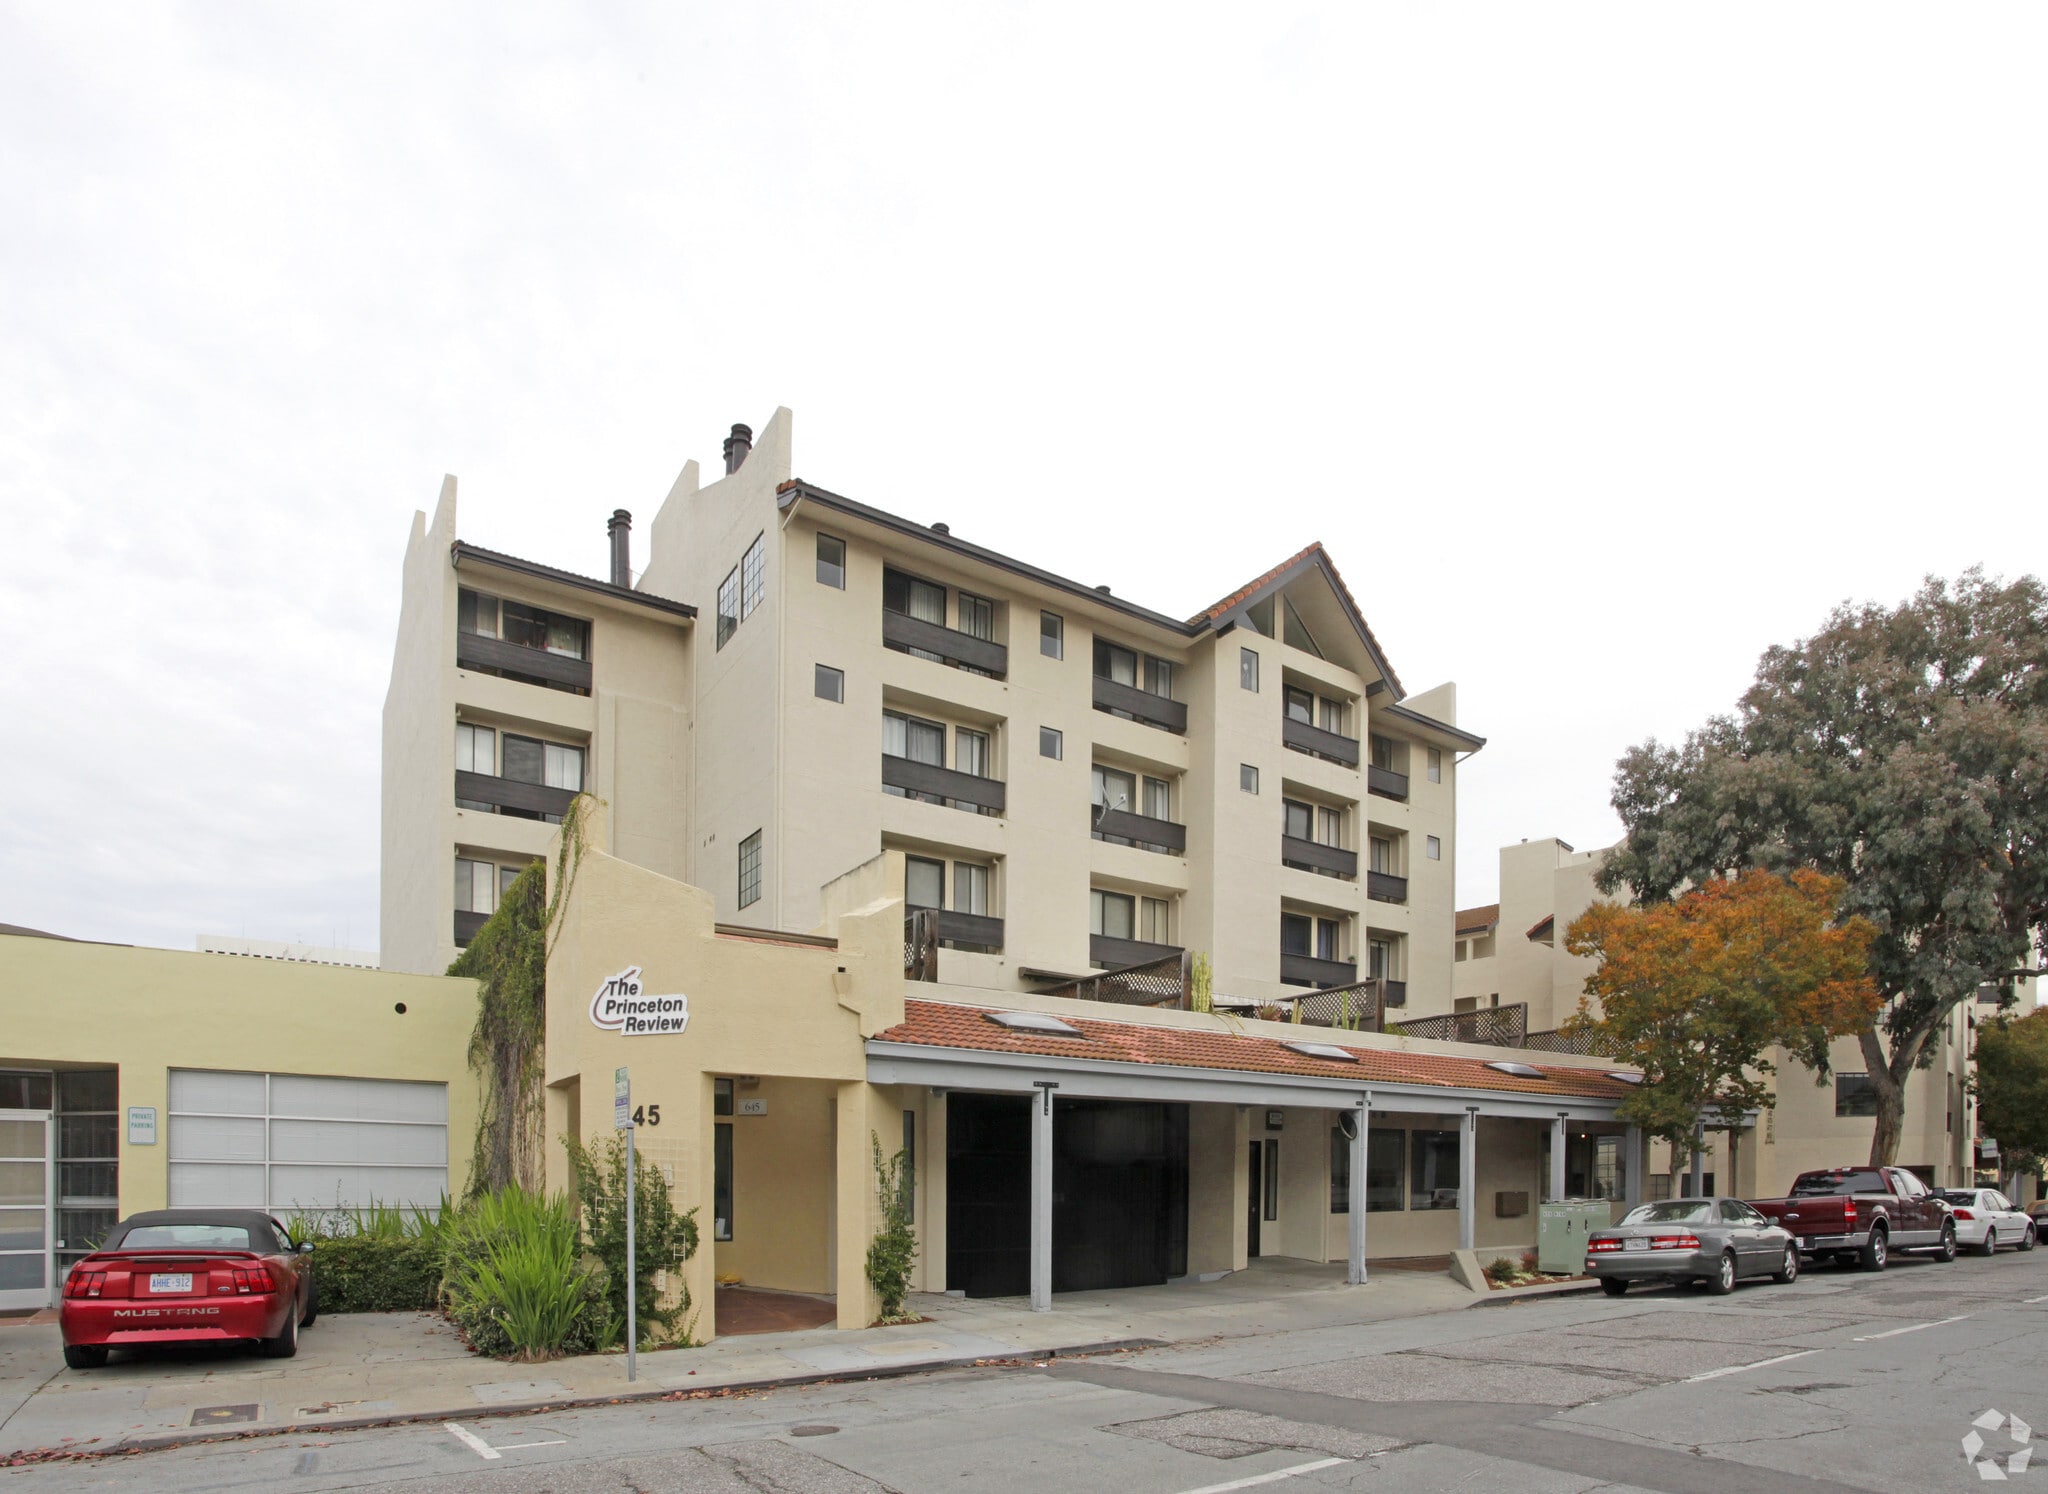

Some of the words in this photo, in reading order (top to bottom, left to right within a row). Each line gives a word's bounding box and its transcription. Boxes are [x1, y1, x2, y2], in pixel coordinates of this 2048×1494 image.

[608, 978, 638, 996] The
[605, 998, 683, 1015] Princeton
[625, 1016, 684, 1032] Review
[131, 1112, 153, 1120] PRIVATE
[113, 1307, 220, 1317] MUSTANG
